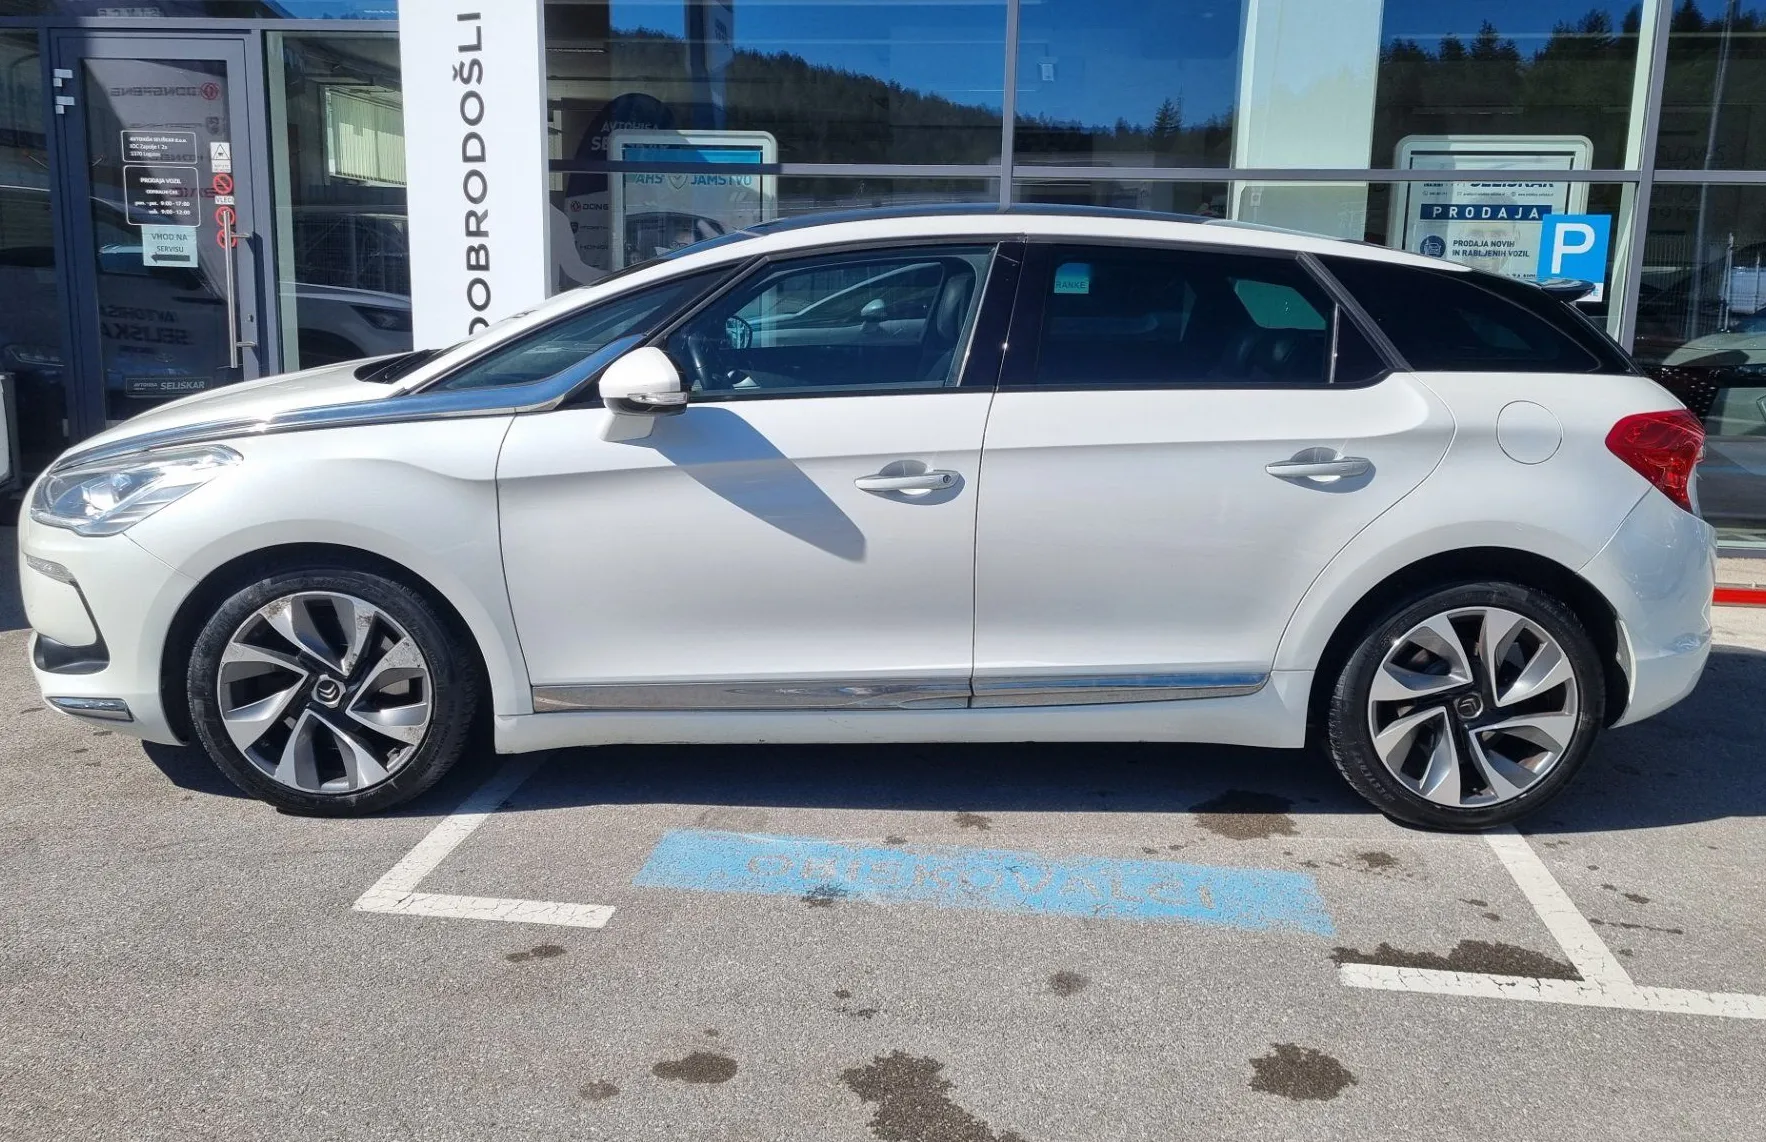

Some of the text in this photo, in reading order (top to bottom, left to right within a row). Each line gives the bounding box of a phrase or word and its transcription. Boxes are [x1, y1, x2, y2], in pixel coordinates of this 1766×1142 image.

[1432, 206, 1540, 219] PRODAJA
[150, 233, 188, 242] VHOD NA
[1452, 239, 1516, 248] PRODAJA NOVIH
[156, 245, 184, 253] SERVISU
[1551, 222, 1596, 275] P
[1452, 249, 1530, 258] IN RABLJENIH VOZIL
